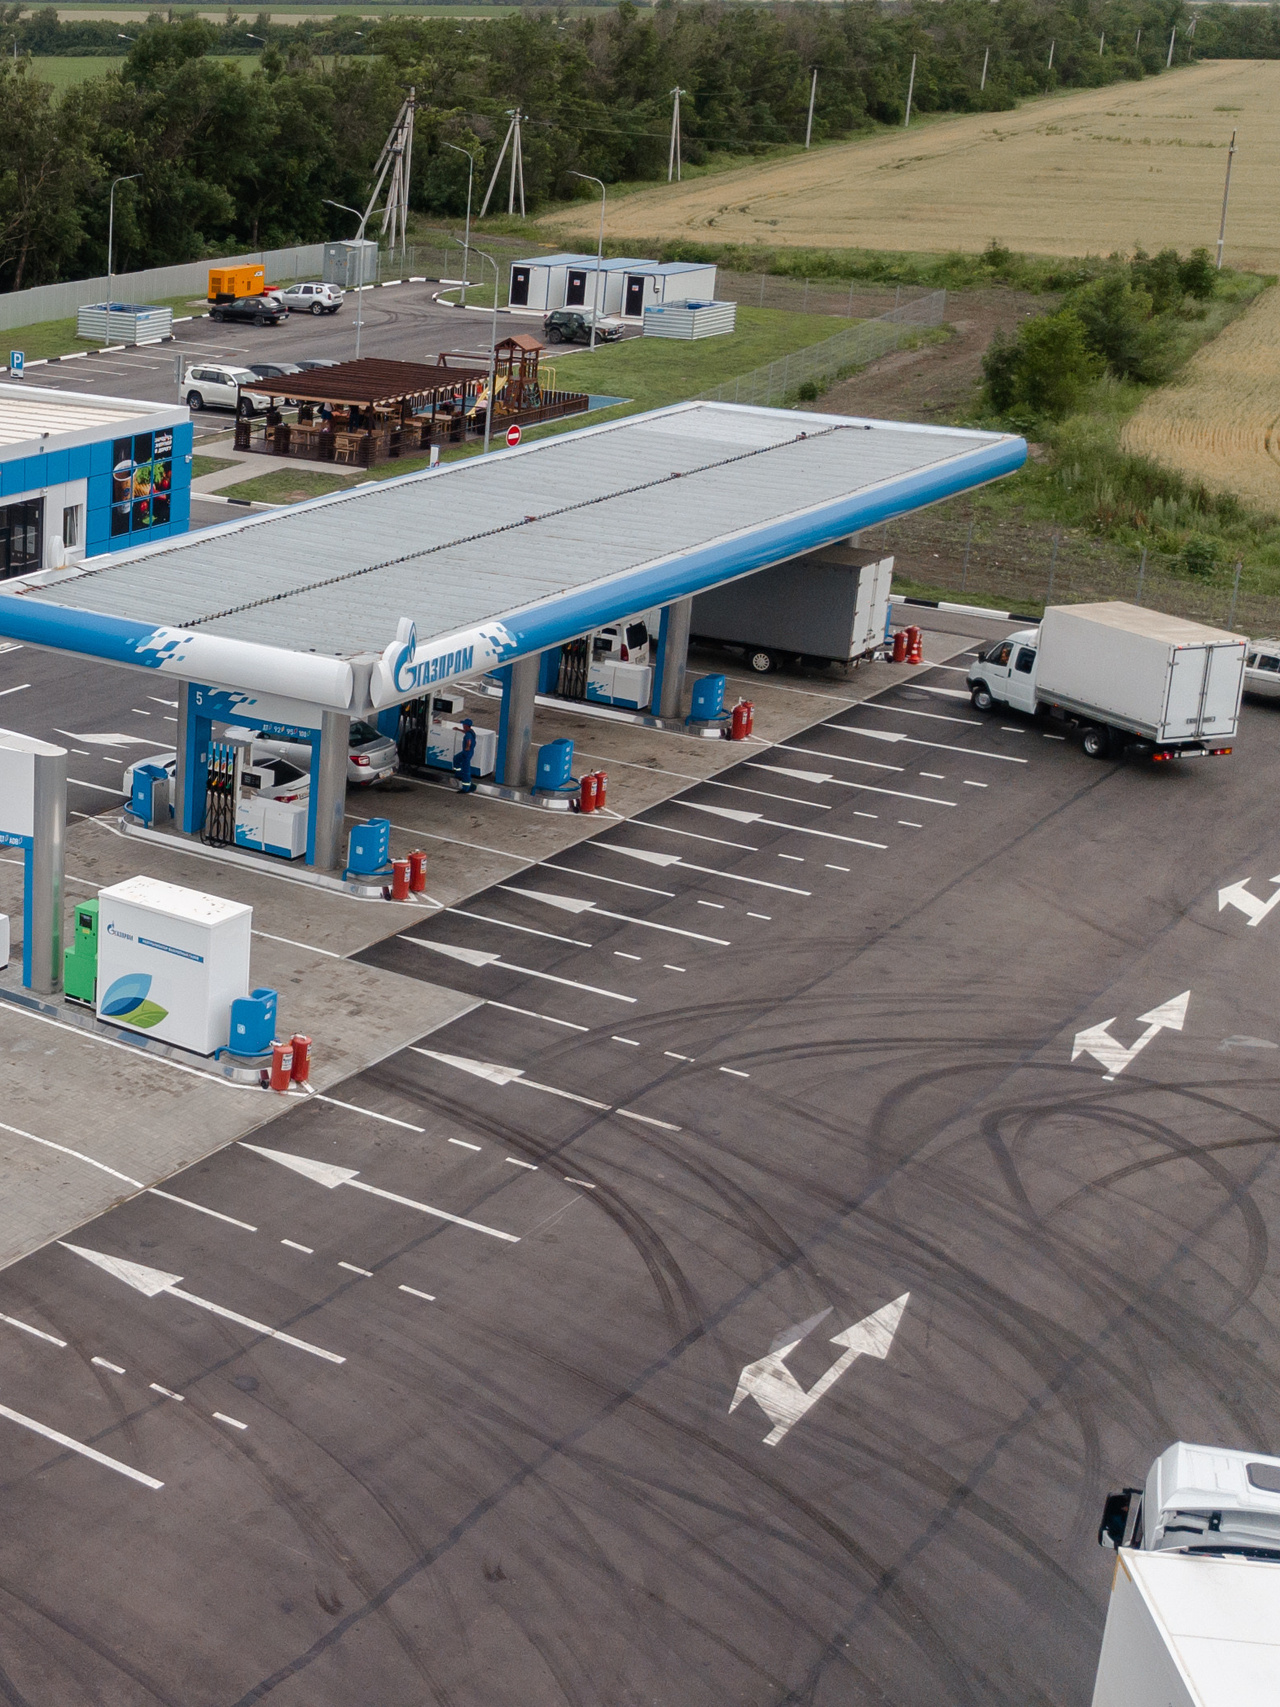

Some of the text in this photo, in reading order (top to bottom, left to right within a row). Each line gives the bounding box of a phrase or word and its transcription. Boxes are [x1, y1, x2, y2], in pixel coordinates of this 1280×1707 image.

[14, 353, 22, 368] P
[417, 645, 474, 687] ГАЗПРОМ
[195, 691, 203, 706] 5
[273, 725, 282, 733] 92
